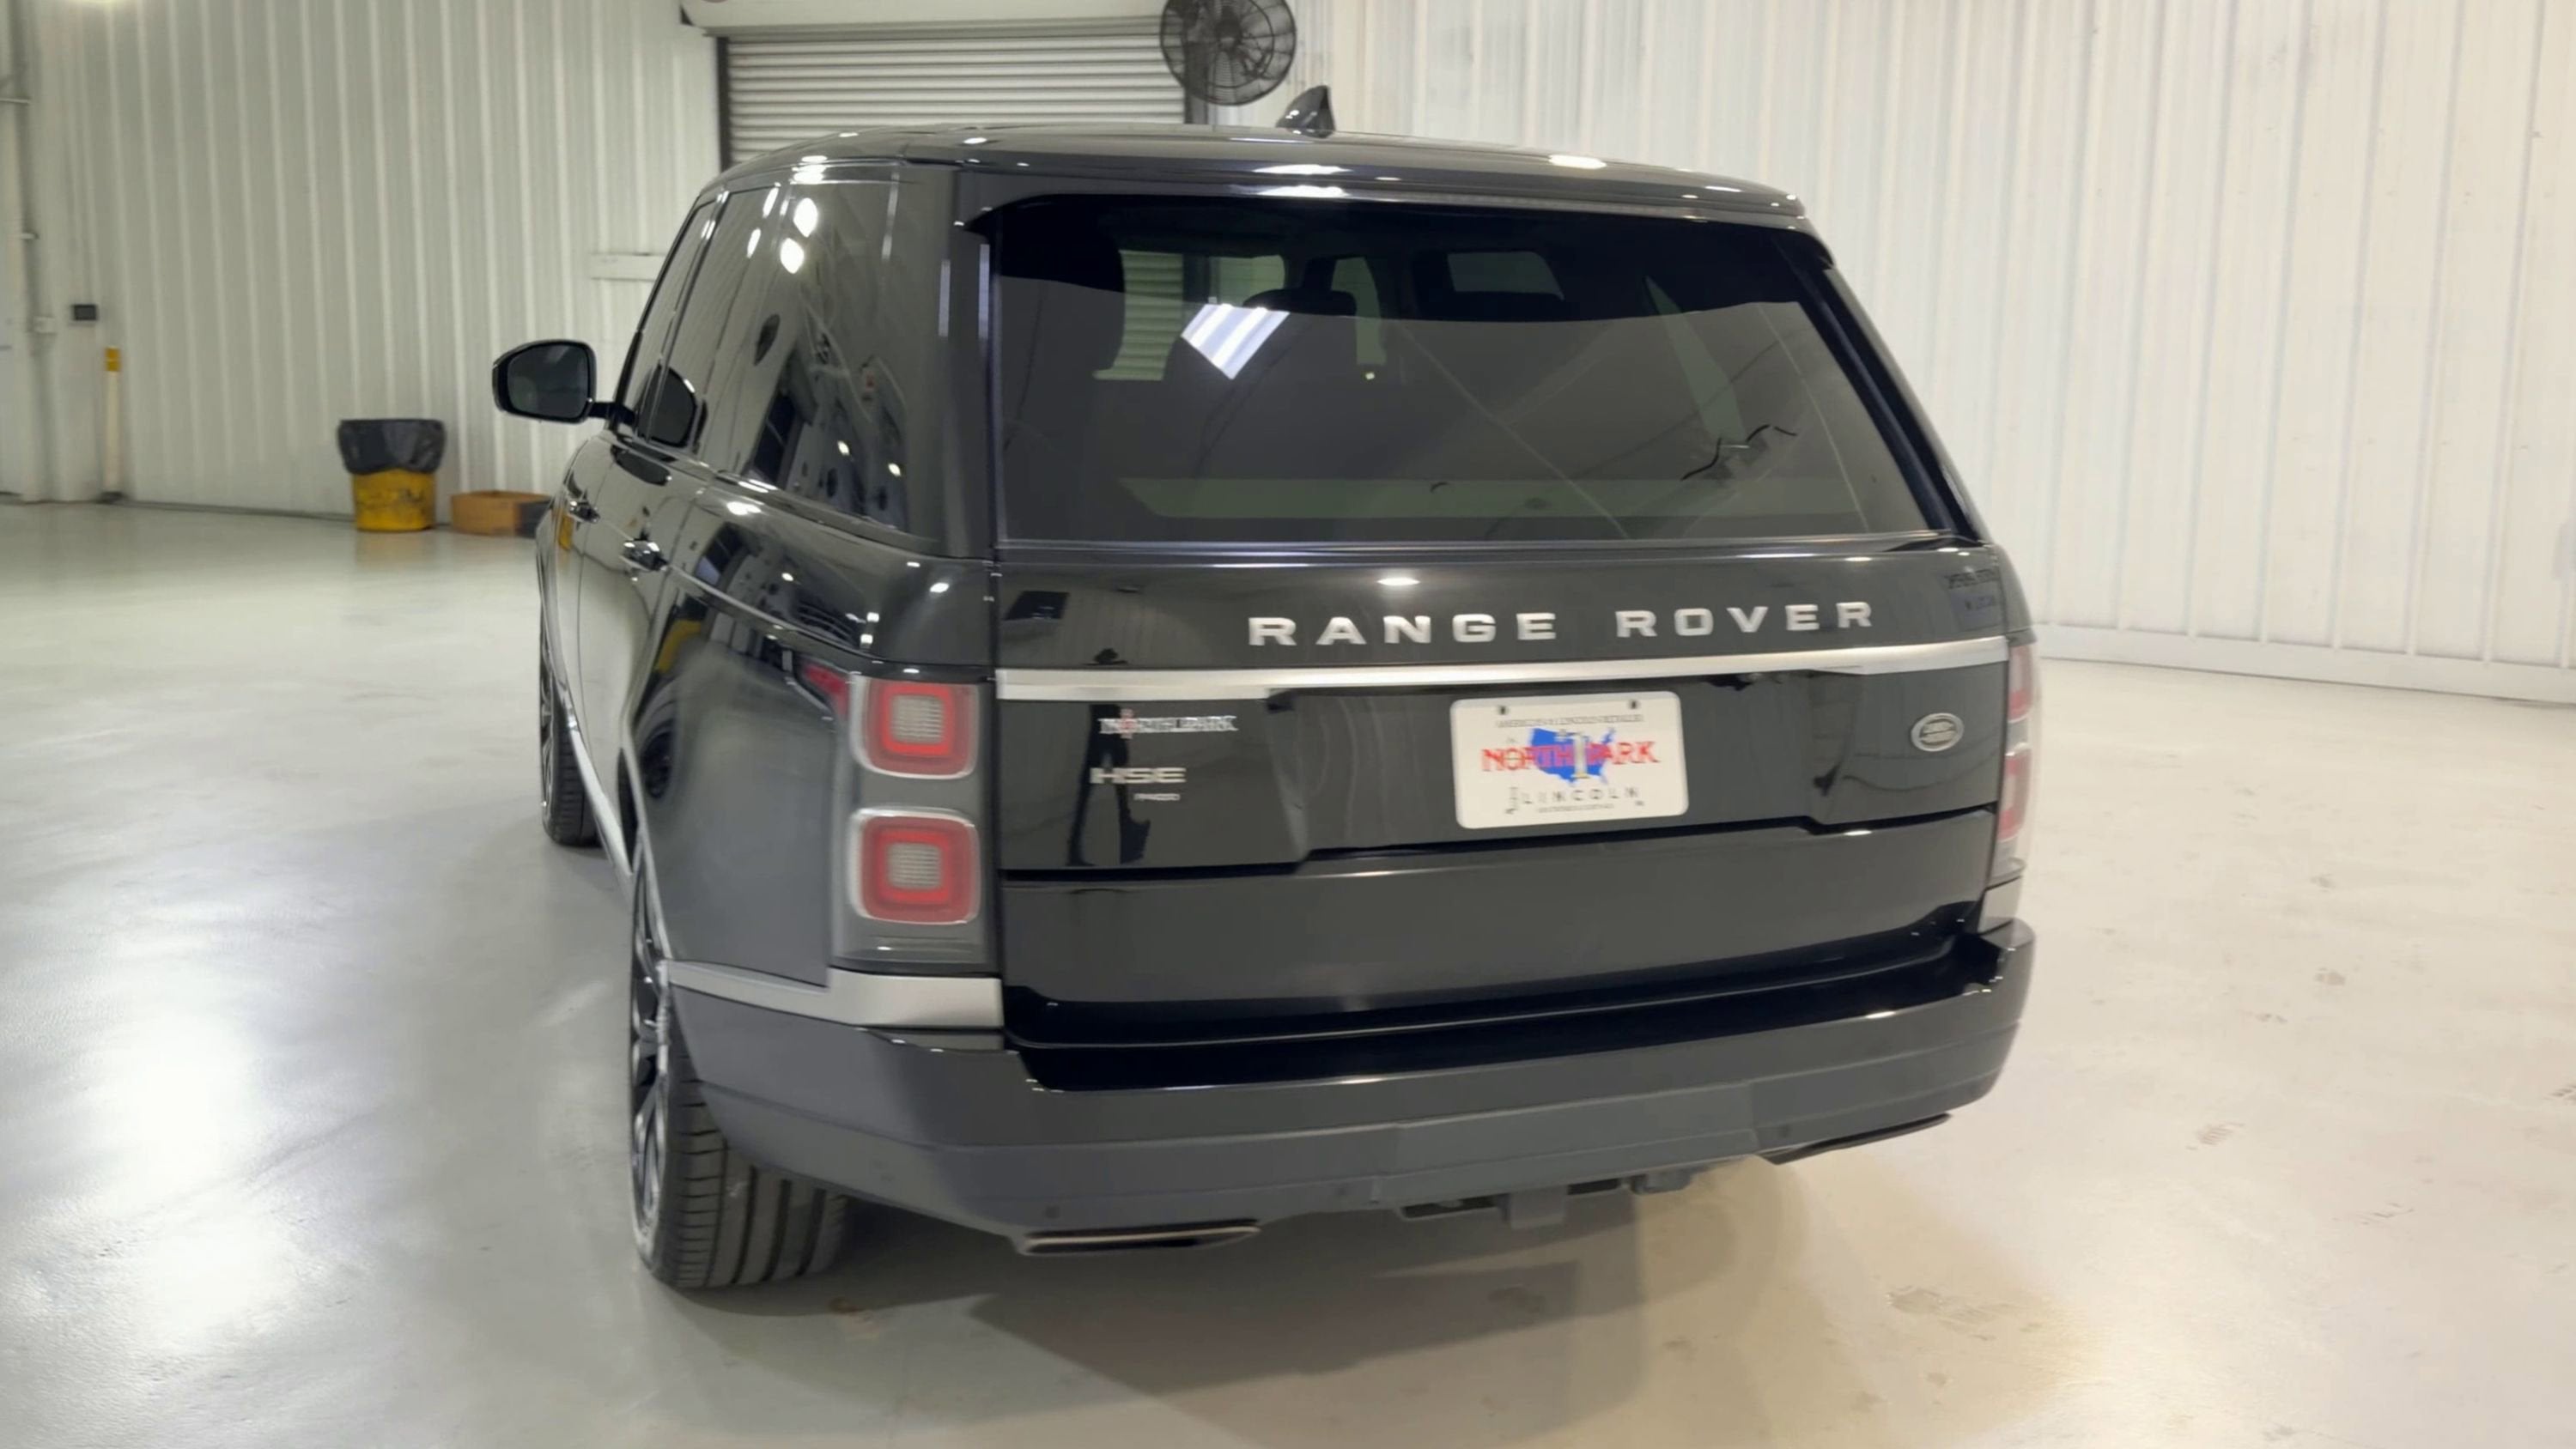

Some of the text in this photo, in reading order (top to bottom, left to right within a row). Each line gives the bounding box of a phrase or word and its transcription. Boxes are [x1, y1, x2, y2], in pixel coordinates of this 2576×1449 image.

[1248, 602, 1873, 646] RANGE ROVER
[1480, 741, 1661, 772] NORTH PARK
[1090, 767, 1187, 784] HSE
